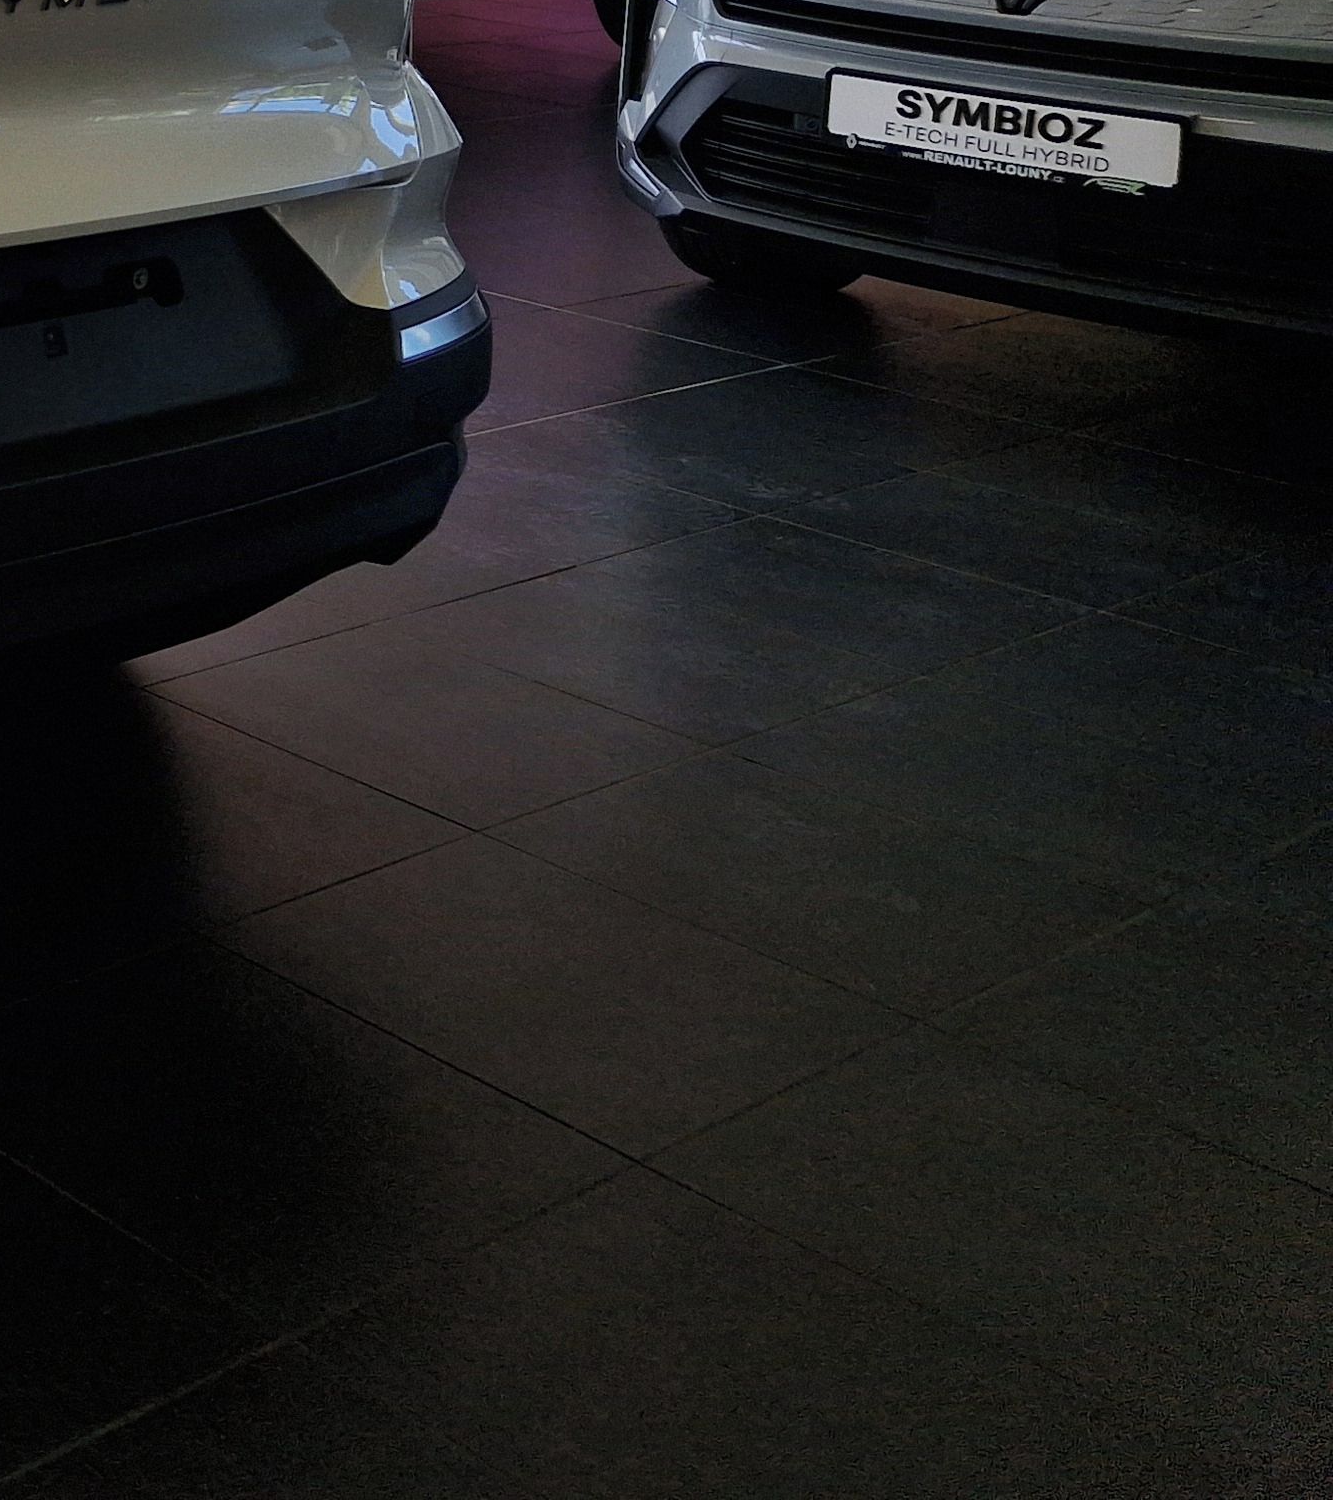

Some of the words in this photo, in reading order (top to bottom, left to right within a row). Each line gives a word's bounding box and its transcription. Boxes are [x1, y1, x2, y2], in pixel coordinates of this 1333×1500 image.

[884, 121, 958, 147] E-TECH
[965, 135, 1016, 158] FULL
[1022, 145, 1110, 172] HYBRID
[896, 89, 1106, 150] SYMBIOZ
